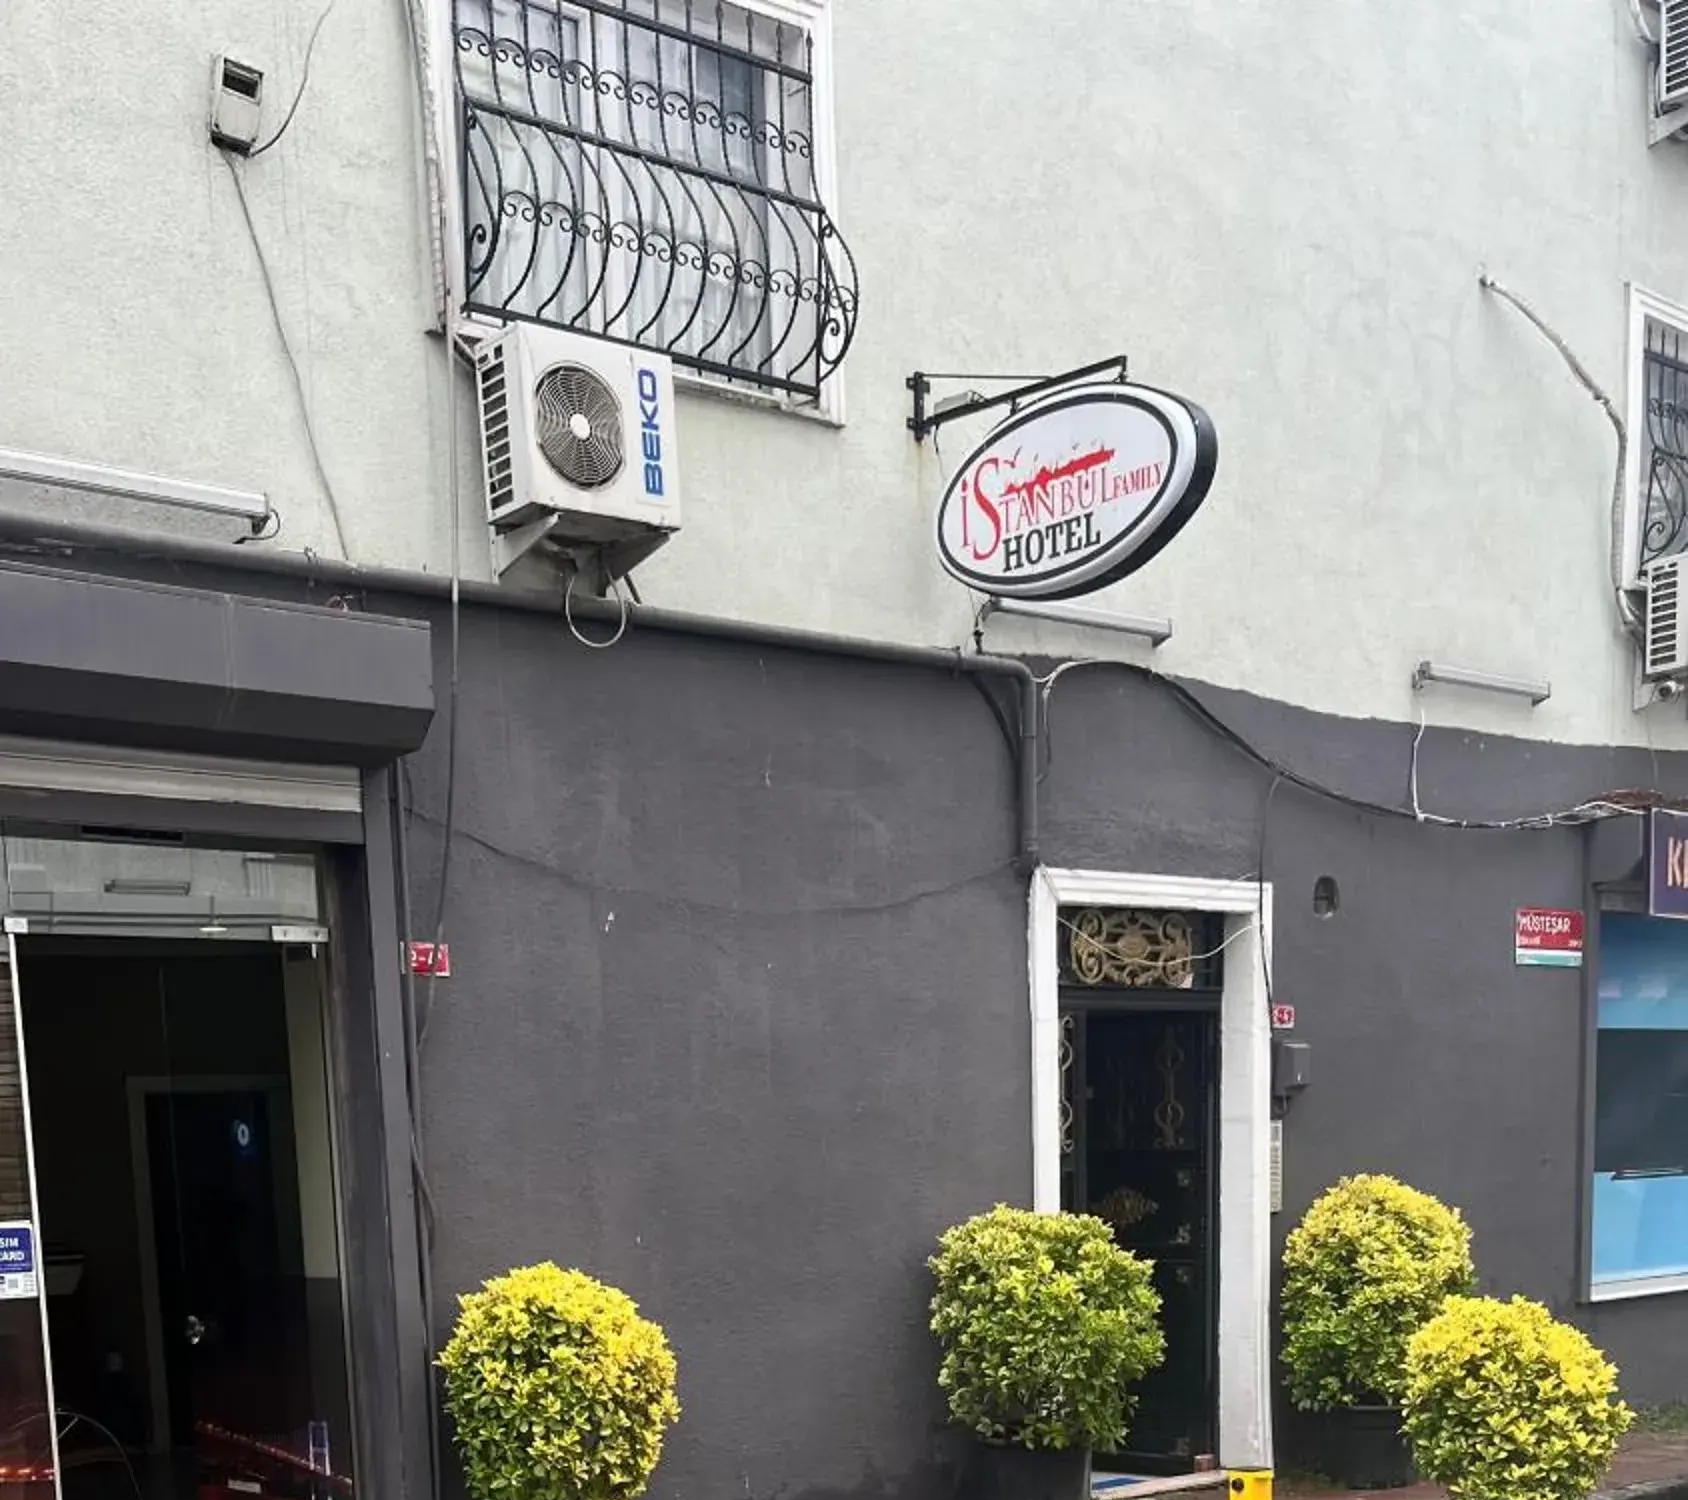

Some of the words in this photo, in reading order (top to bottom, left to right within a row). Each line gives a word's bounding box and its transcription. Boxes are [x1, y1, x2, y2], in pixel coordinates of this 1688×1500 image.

[638, 369, 664, 496] BEKO
[1113, 461, 1164, 499] FAMILY
[1002, 511, 1101, 573] HOTEL
